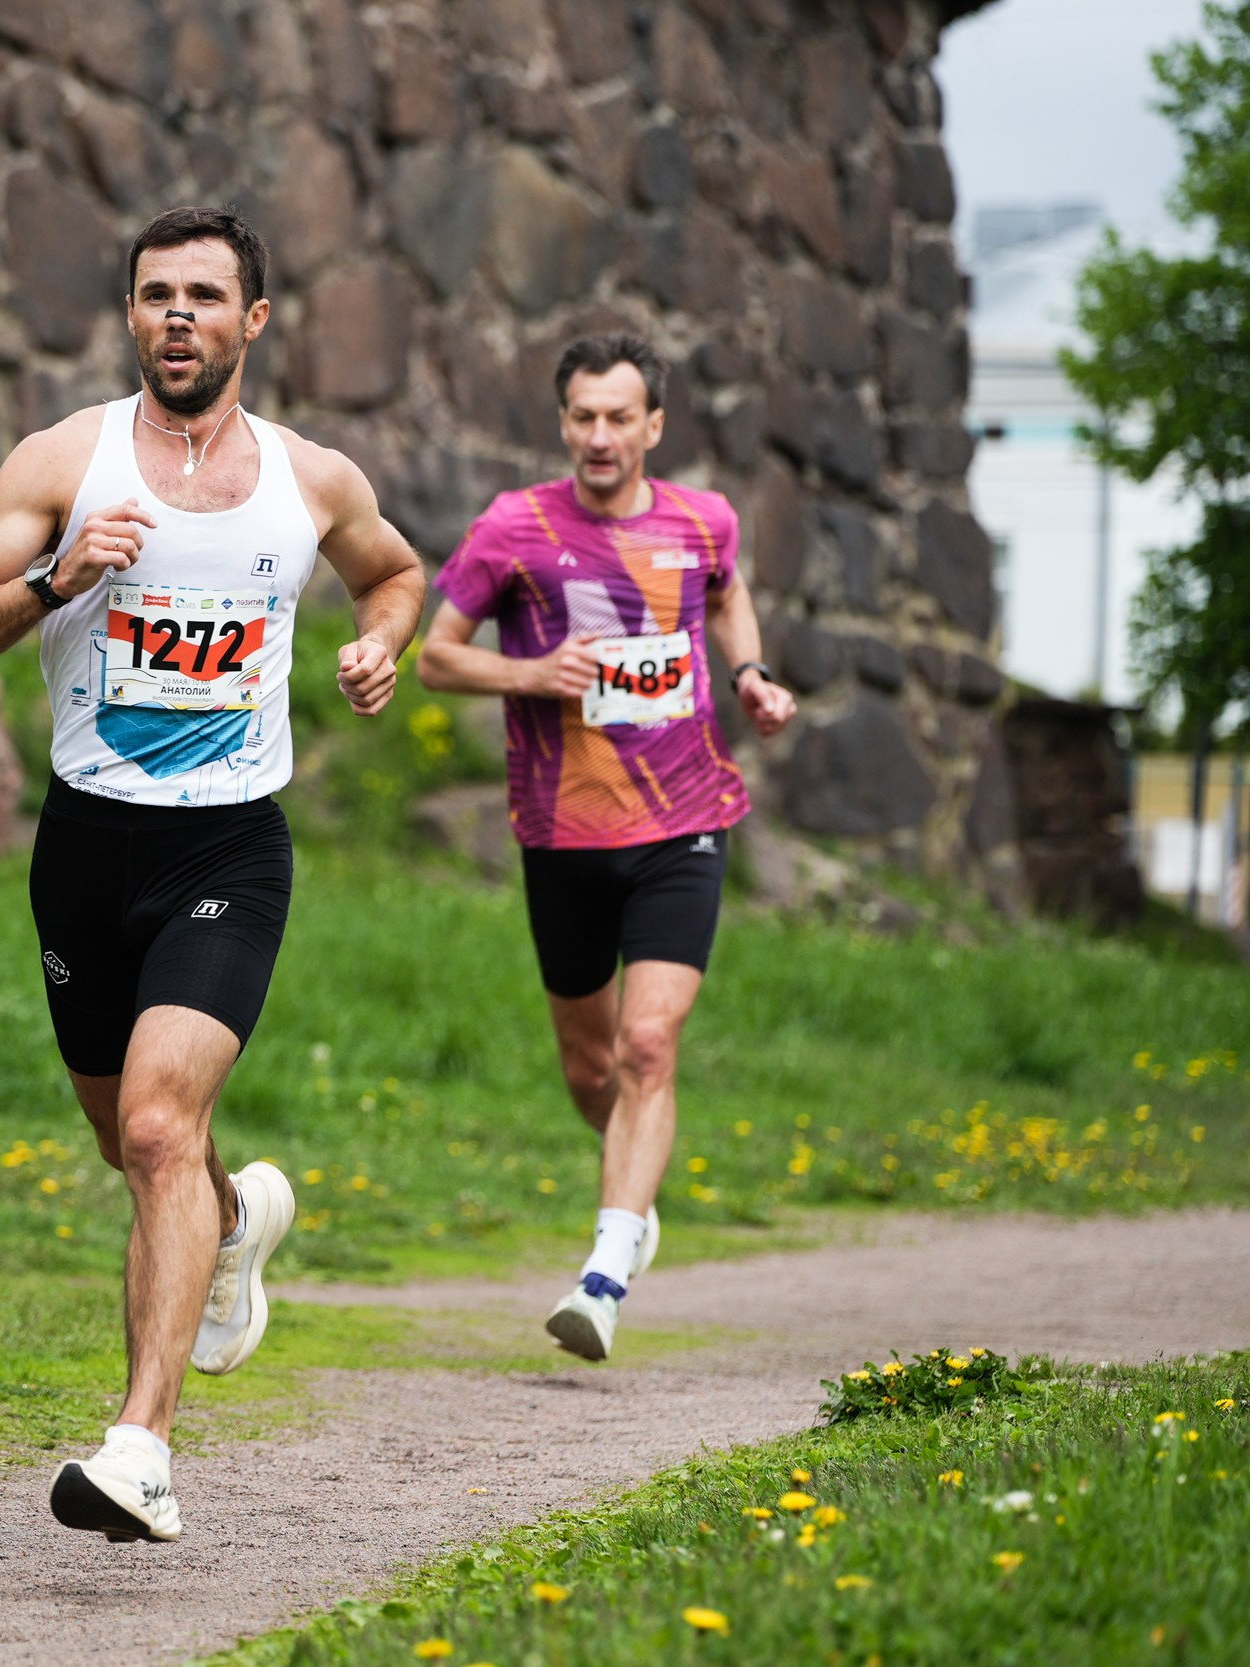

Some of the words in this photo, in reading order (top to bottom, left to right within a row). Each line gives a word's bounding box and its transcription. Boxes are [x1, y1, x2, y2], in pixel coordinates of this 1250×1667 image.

[128, 617, 245, 672] 1272
[160, 686, 211, 695] АНАТОЛИЙ
[597, 657, 681, 697] 1485
